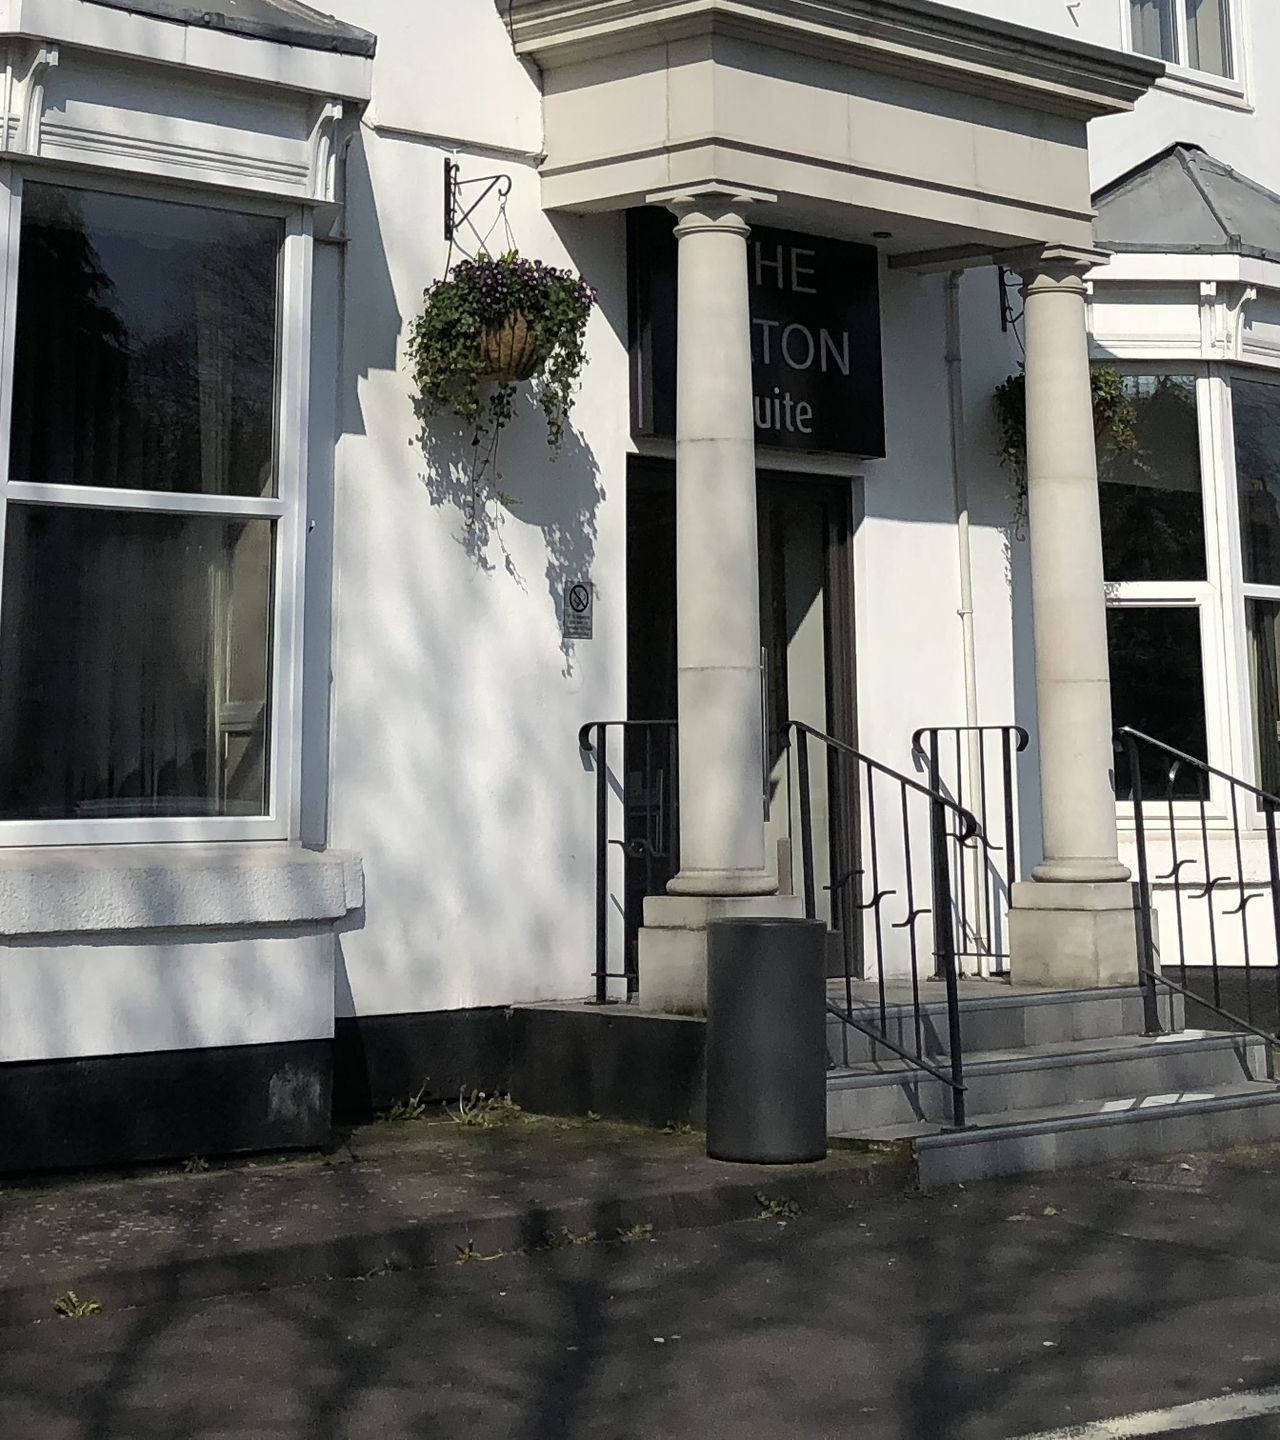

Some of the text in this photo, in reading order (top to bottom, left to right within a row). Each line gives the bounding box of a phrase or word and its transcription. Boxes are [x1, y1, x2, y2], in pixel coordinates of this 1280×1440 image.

[752, 240, 817, 294] HE
[751, 318, 850, 376] TON
[754, 387, 813, 434] uite
